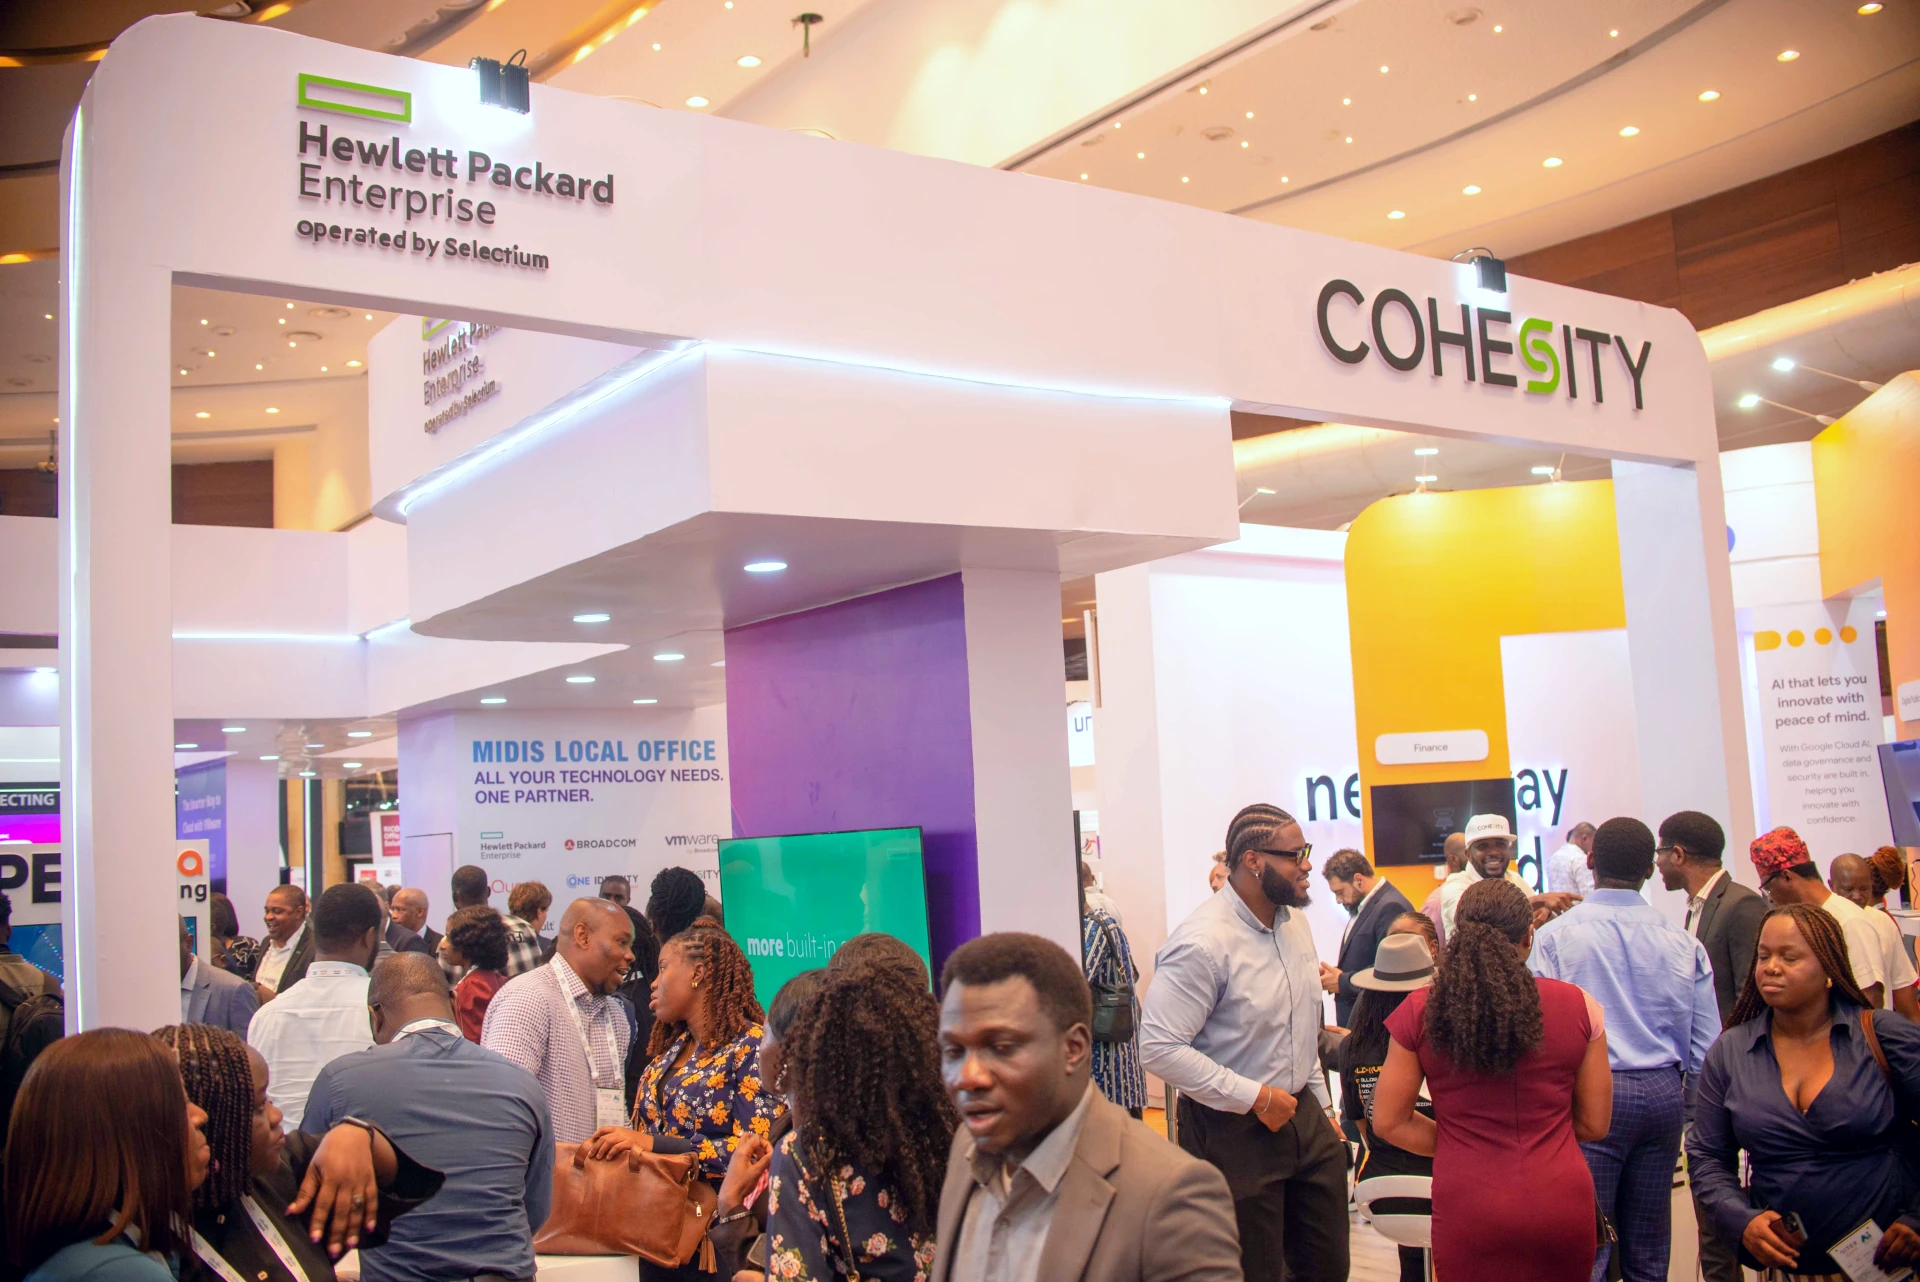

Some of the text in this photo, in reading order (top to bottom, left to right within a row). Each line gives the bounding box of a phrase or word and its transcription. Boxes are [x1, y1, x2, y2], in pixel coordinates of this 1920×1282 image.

[298, 121, 615, 205] Hewlett Packard
[298, 163, 497, 225] Enterprise
[296, 219, 550, 269] operated by Selectium
[423, 328, 467, 375] Hewlett
[1316, 279, 1652, 411] COHESITY
[424, 356, 480, 406] Enterprise
[1772, 675, 1868, 690] AI that lets you
[1777, 691, 1865, 708] innovate with
[1775, 710, 1871, 730] peace of mind.
[472, 740, 716, 763] MIDIS LOCAL OFFICE
[1413, 743, 1449, 753] Finance
[1779, 744, 1800, 753] With
[1801, 742, 1833, 752] Google
[1834, 741, 1860, 750] Cloud
[1782, 755, 1872, 768] data governance and
[474, 768, 724, 785] ALL YOUR TECHNOLOGY NEEDS.
[1787, 773, 1822, 783] security
[1824, 772, 1838, 780] are
[1839, 770, 1858, 779] built
[475, 788, 594, 804] ONE PARTNER.
[1805, 786, 1855, 796] helping you
[1802, 800, 1860, 810] innovate with
[480, 841, 546, 851] Hewlett Packard
[576, 839, 637, 849] BROADCOM
[665, 833, 719, 846] vmware
[480, 851, 521, 861] Enterprise
[567, 874, 591, 887] ONE
[747, 931, 836, 959] more built-in
